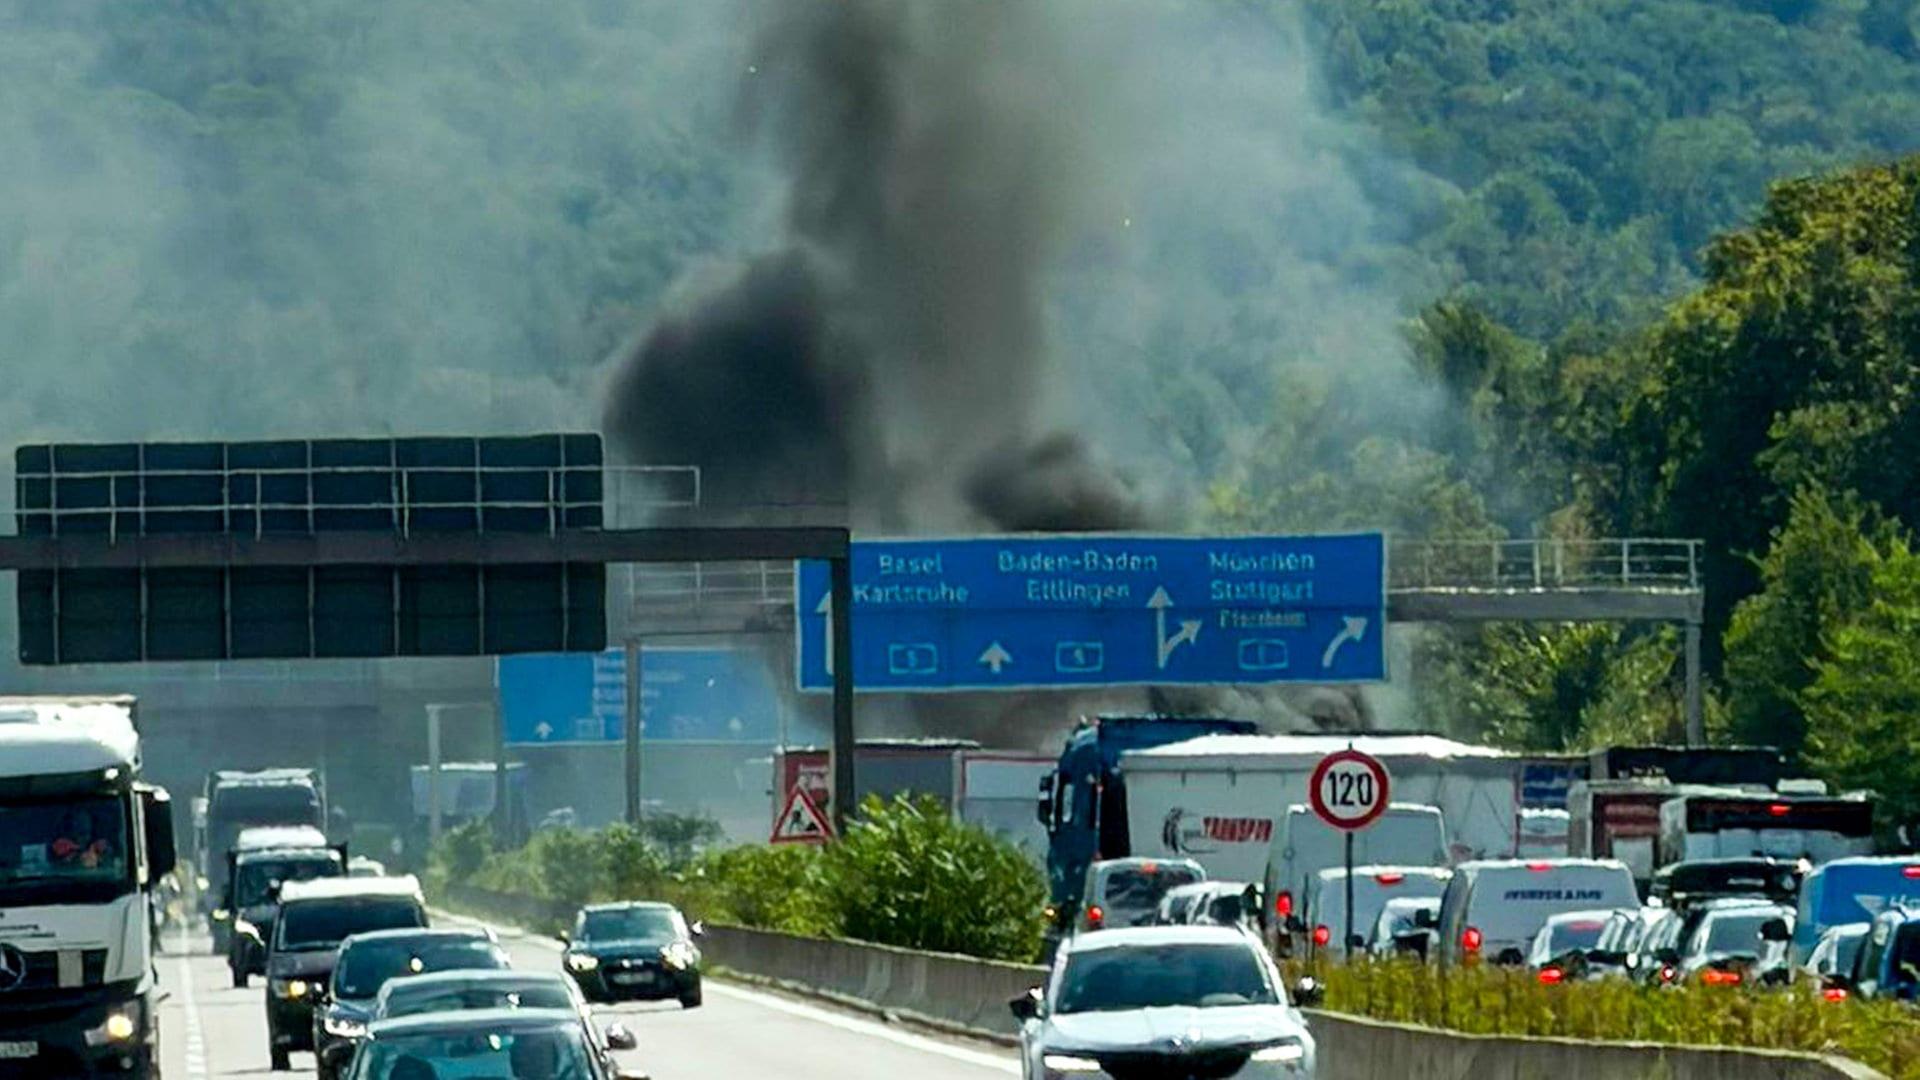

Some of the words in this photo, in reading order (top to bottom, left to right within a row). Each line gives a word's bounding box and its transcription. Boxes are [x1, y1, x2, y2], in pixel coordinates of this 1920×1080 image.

[879, 552, 942, 574] Basel
[998, 550, 1158, 571] Baden-Baden
[1328, 771, 1373, 806] 120
